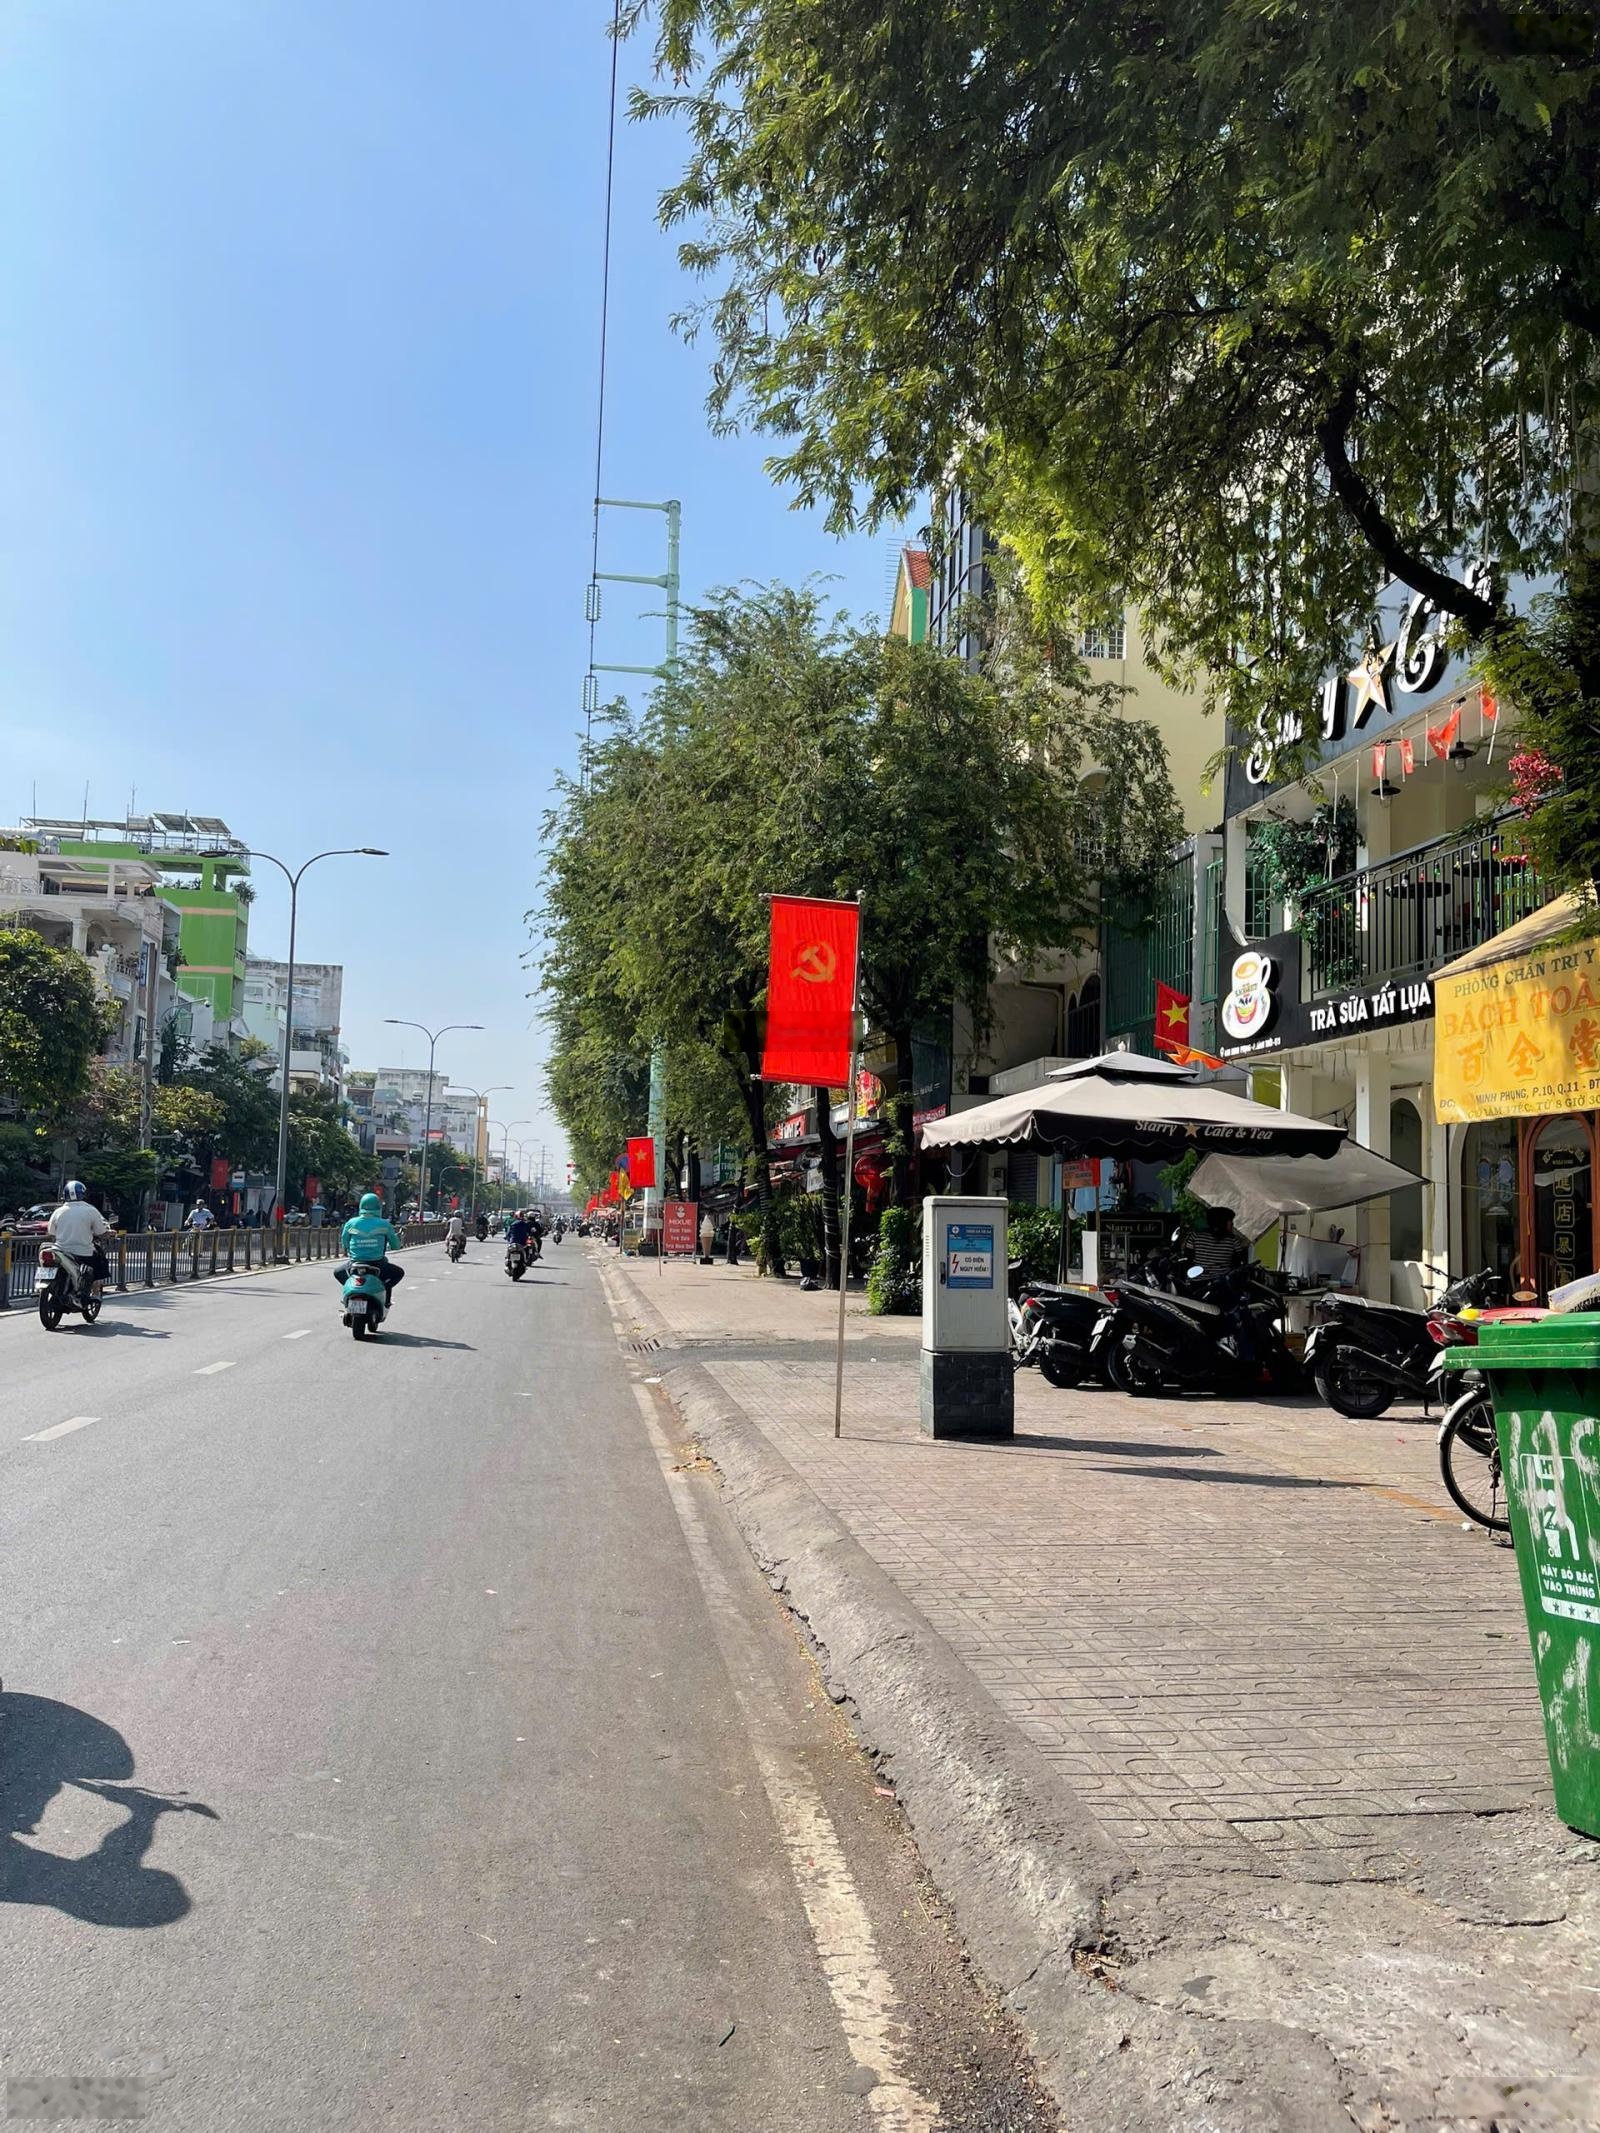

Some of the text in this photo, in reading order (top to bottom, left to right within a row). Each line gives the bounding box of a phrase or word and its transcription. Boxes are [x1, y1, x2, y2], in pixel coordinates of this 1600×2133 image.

[1454, 974, 1499, 998] PHÒNG
[1551, 955, 1579, 974] TRỊ
[1310, 980, 1432, 1031] TRÀ SỮA TẤT LỤA
[1442, 972, 1600, 1039] BÁCH TOÀ
[1475, 1092, 1498, 1105] MINH
[1532, 1084, 1555, 1098] P.10,
[1557, 1081, 1579, 1095] Q.11
[1565, 1094, 1585, 1108] GIỜ
[1135, 1120, 1178, 1137] Starry
[1235, 1127, 1247, 1139] &
[1250, 1128, 1273, 1140] Tea
[1540, 1563, 1595, 1584] HÃY BỎ RÁC
[1543, 1577, 1596, 1599] VÀO THÙNG
